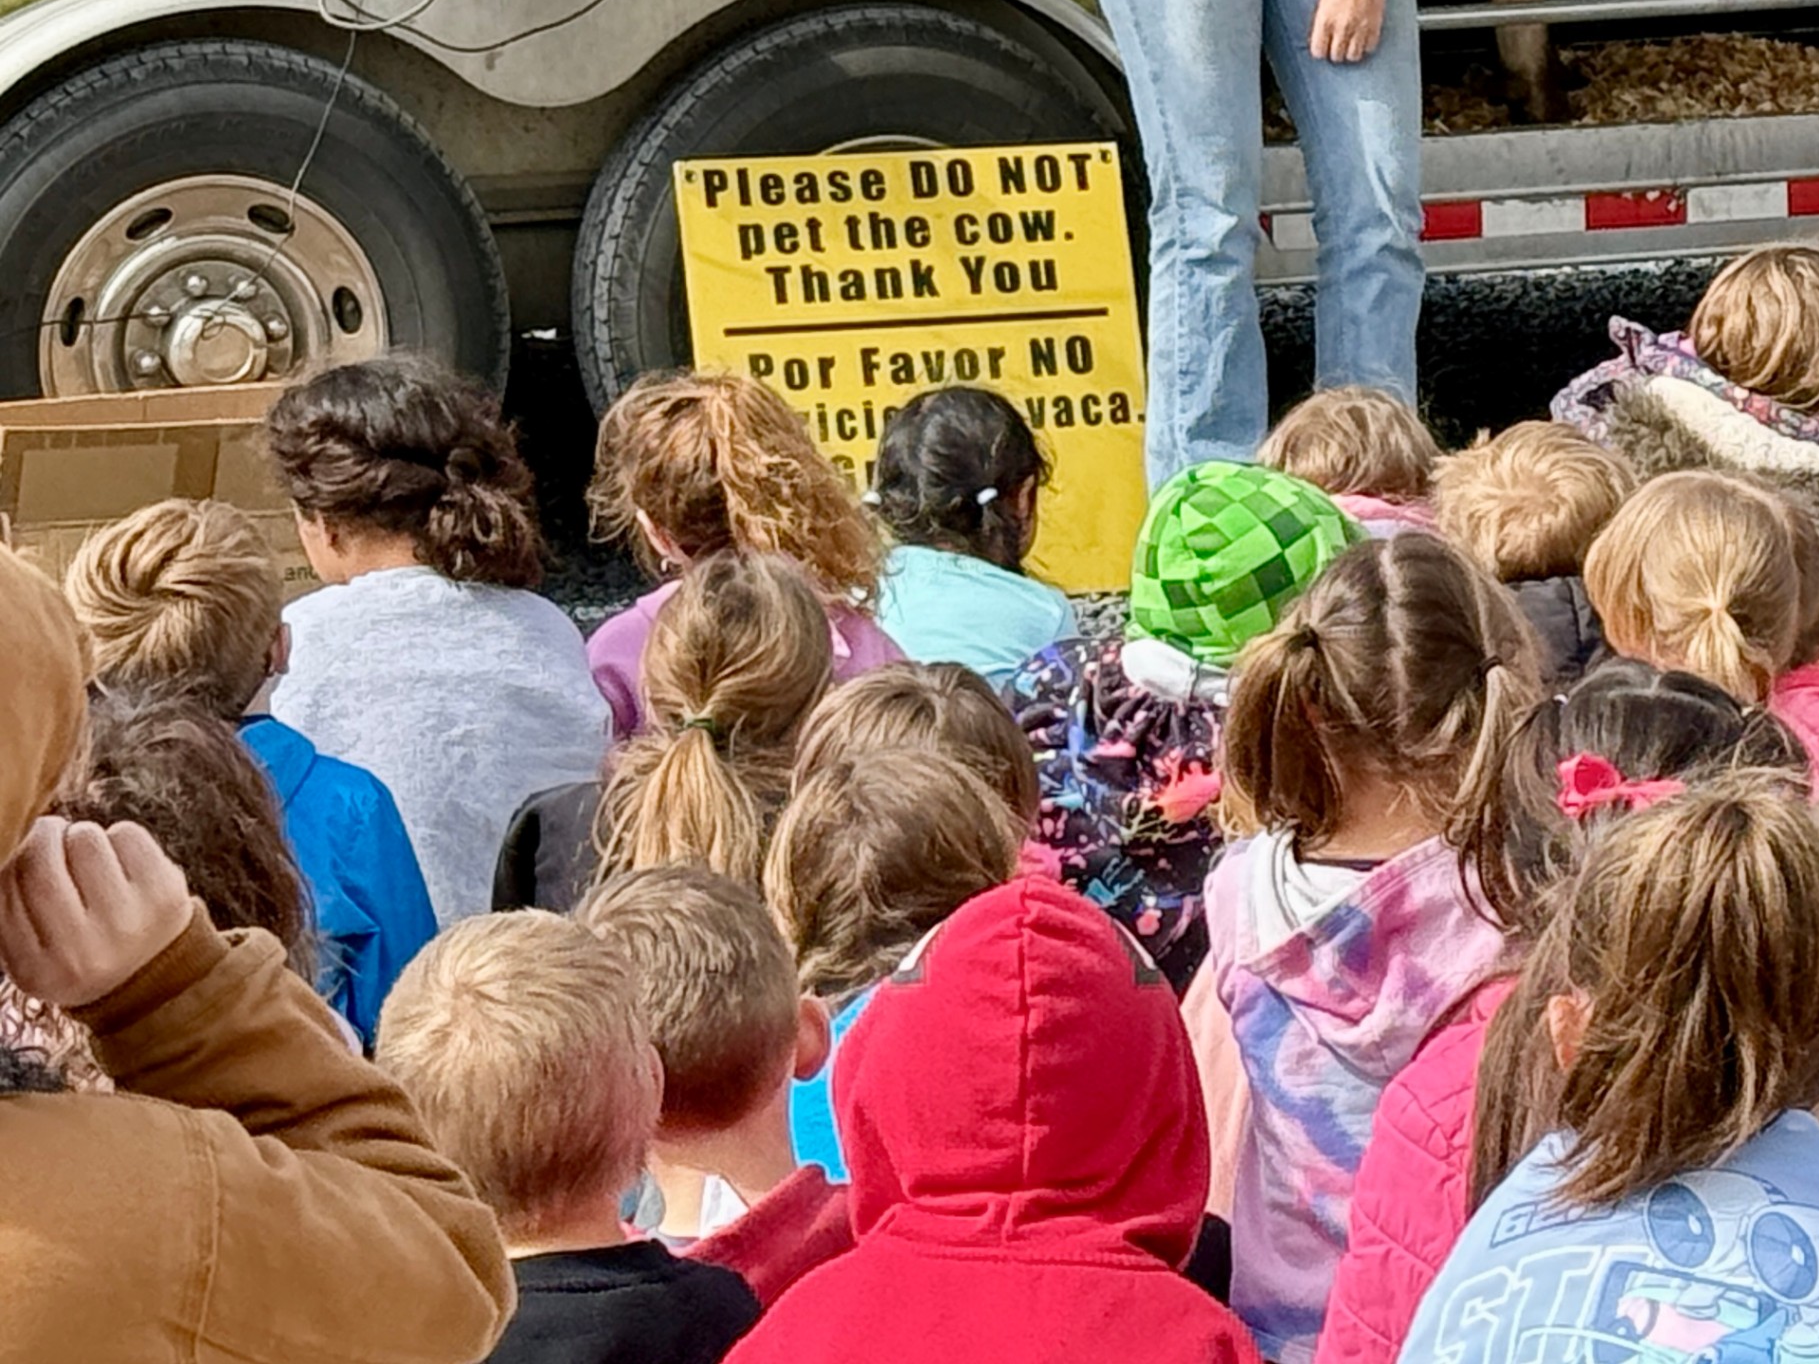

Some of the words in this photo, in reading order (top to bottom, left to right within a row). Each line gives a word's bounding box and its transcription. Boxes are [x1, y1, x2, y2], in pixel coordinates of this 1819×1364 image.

[702, 167, 887, 208] Please
[909, 158, 975, 199] DO
[997, 153, 1092, 195] NOT
[738, 216, 826, 261] pet
[844, 211, 931, 251] the
[954, 209, 1074, 246] cow.
[764, 259, 940, 305] Thank
[959, 254, 1058, 295] You
[748, 353, 836, 391] Por
[860, 345, 1006, 386] Favor
[1029, 335, 1094, 377] NO
[1025, 391, 1146, 430] vaca.
